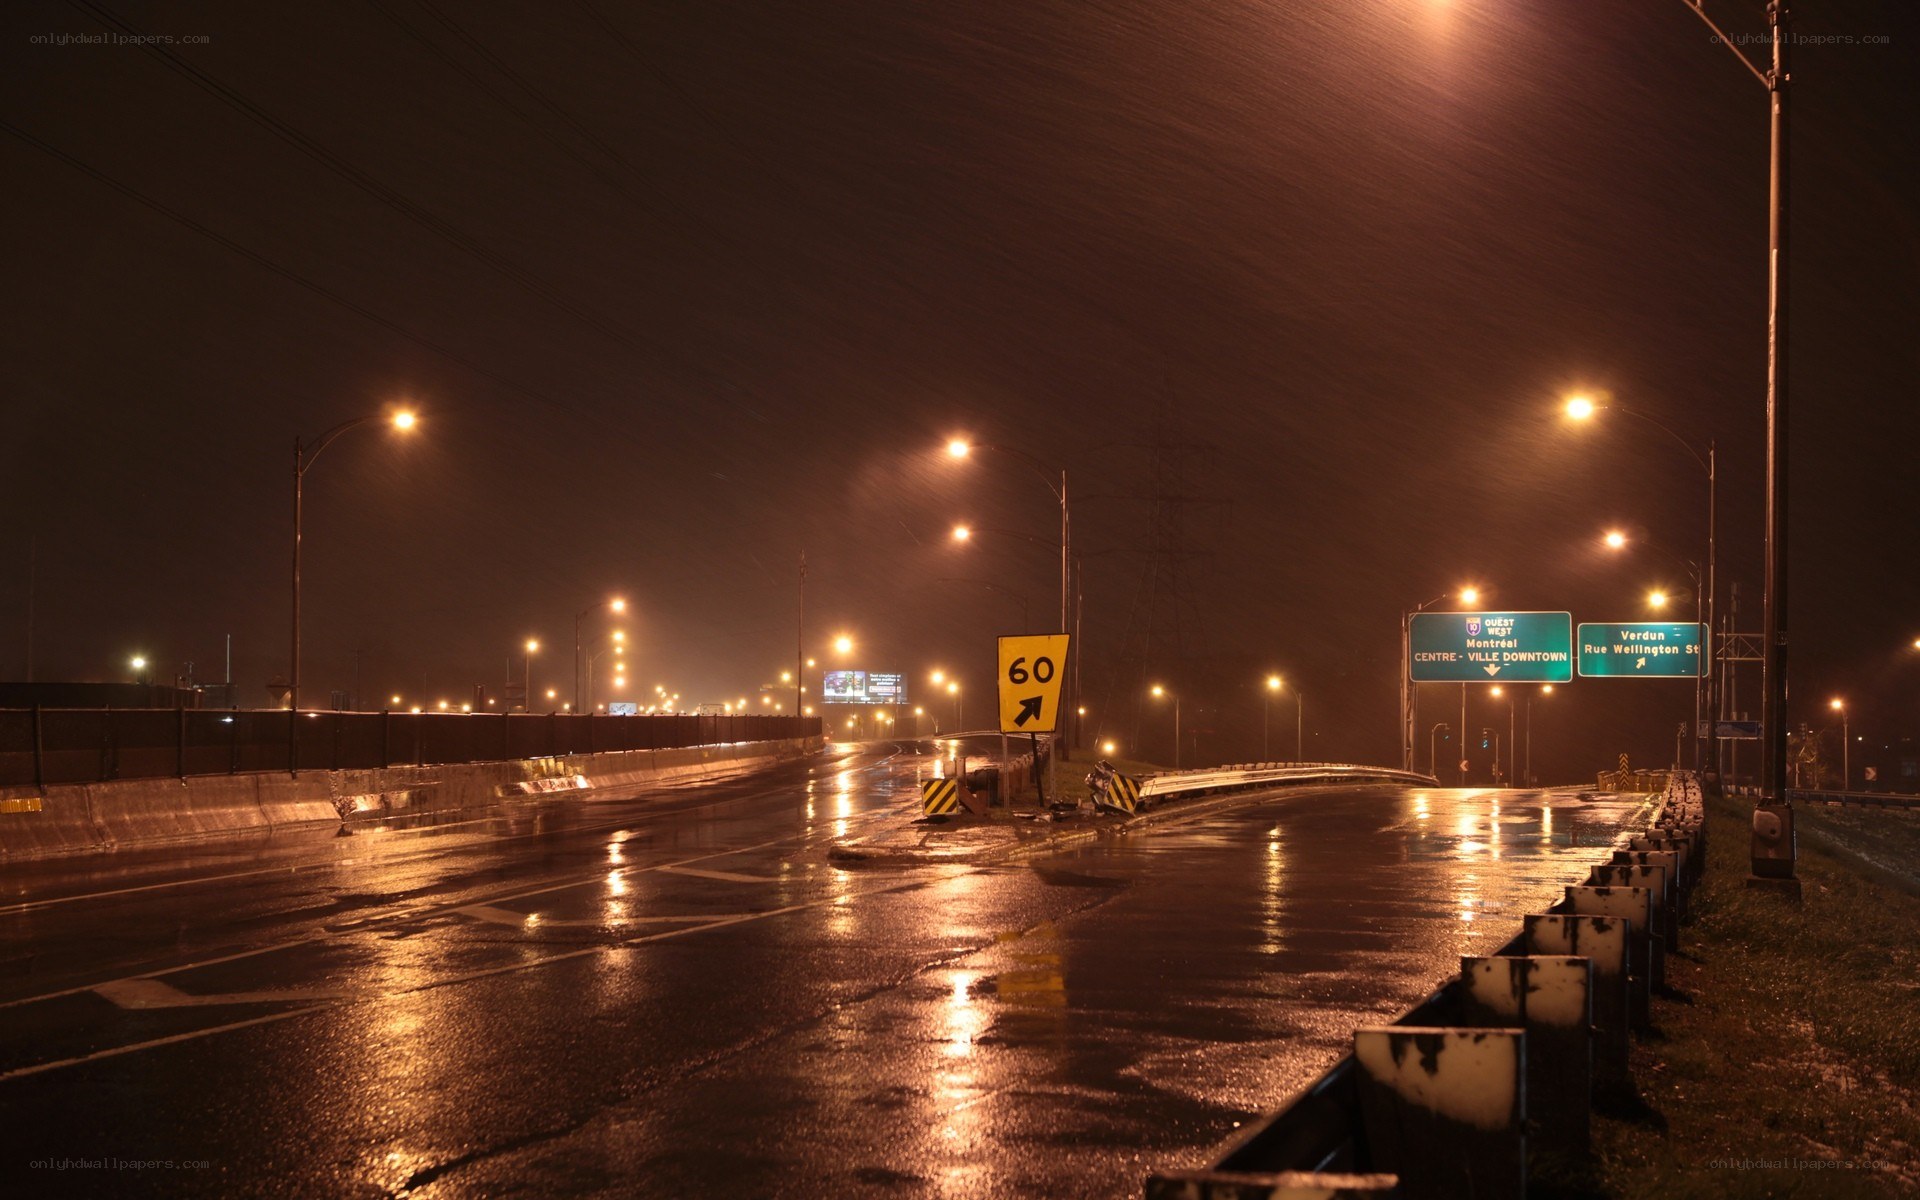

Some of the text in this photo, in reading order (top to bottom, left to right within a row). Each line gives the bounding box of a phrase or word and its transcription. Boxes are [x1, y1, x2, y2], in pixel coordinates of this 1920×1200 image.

[1469, 623, 1478, 631] 10
[1484, 618, 1514, 627] OUEST
[1487, 627, 1512, 636] WEST
[1621, 631, 1665, 641] Verdun
[1466, 638, 1518, 648] Montréal
[1584, 644, 1699, 657] Rue Wellington St
[1414, 652, 1457, 662] CENTRE
[1467, 652, 1500, 662] VILLE
[1502, 652, 1567, 662] DOWNTOWN
[1008, 656, 1055, 685] 60
